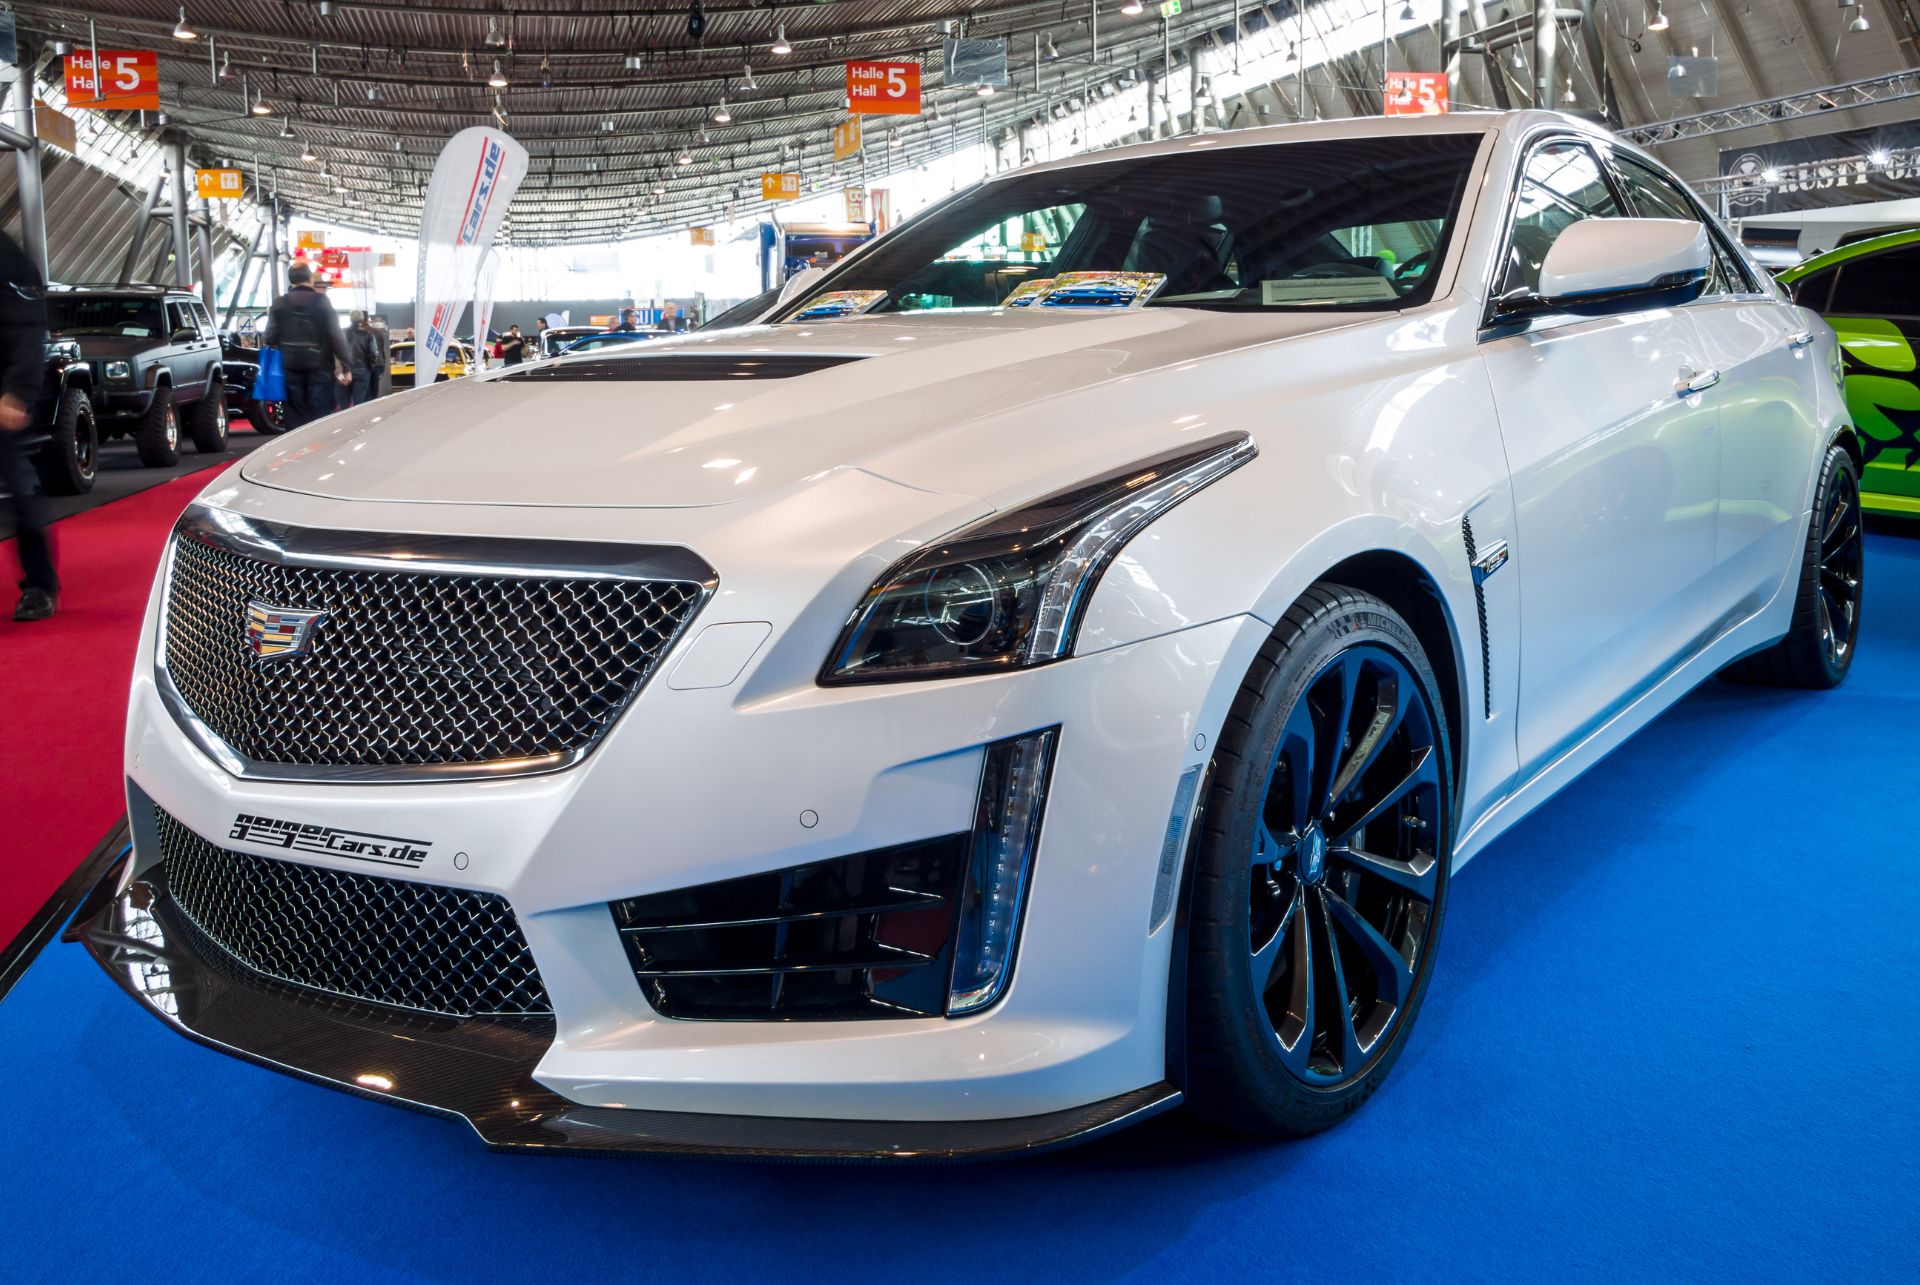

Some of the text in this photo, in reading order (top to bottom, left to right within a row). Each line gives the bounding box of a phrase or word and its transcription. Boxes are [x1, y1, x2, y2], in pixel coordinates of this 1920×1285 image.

[71, 56, 111, 70] Hale
[115, 56, 140, 90] 5
[852, 66, 884, 79] Halle
[72, 75, 102, 89] Hal
[852, 84, 877, 97] Hall
[886, 67, 907, 98] 5
[1389, 77, 1417, 90] Hale
[1418, 78, 1436, 106] 5
[1778, 155, 1869, 193] RUSTY
[462, 142, 501, 244] Cars.de
